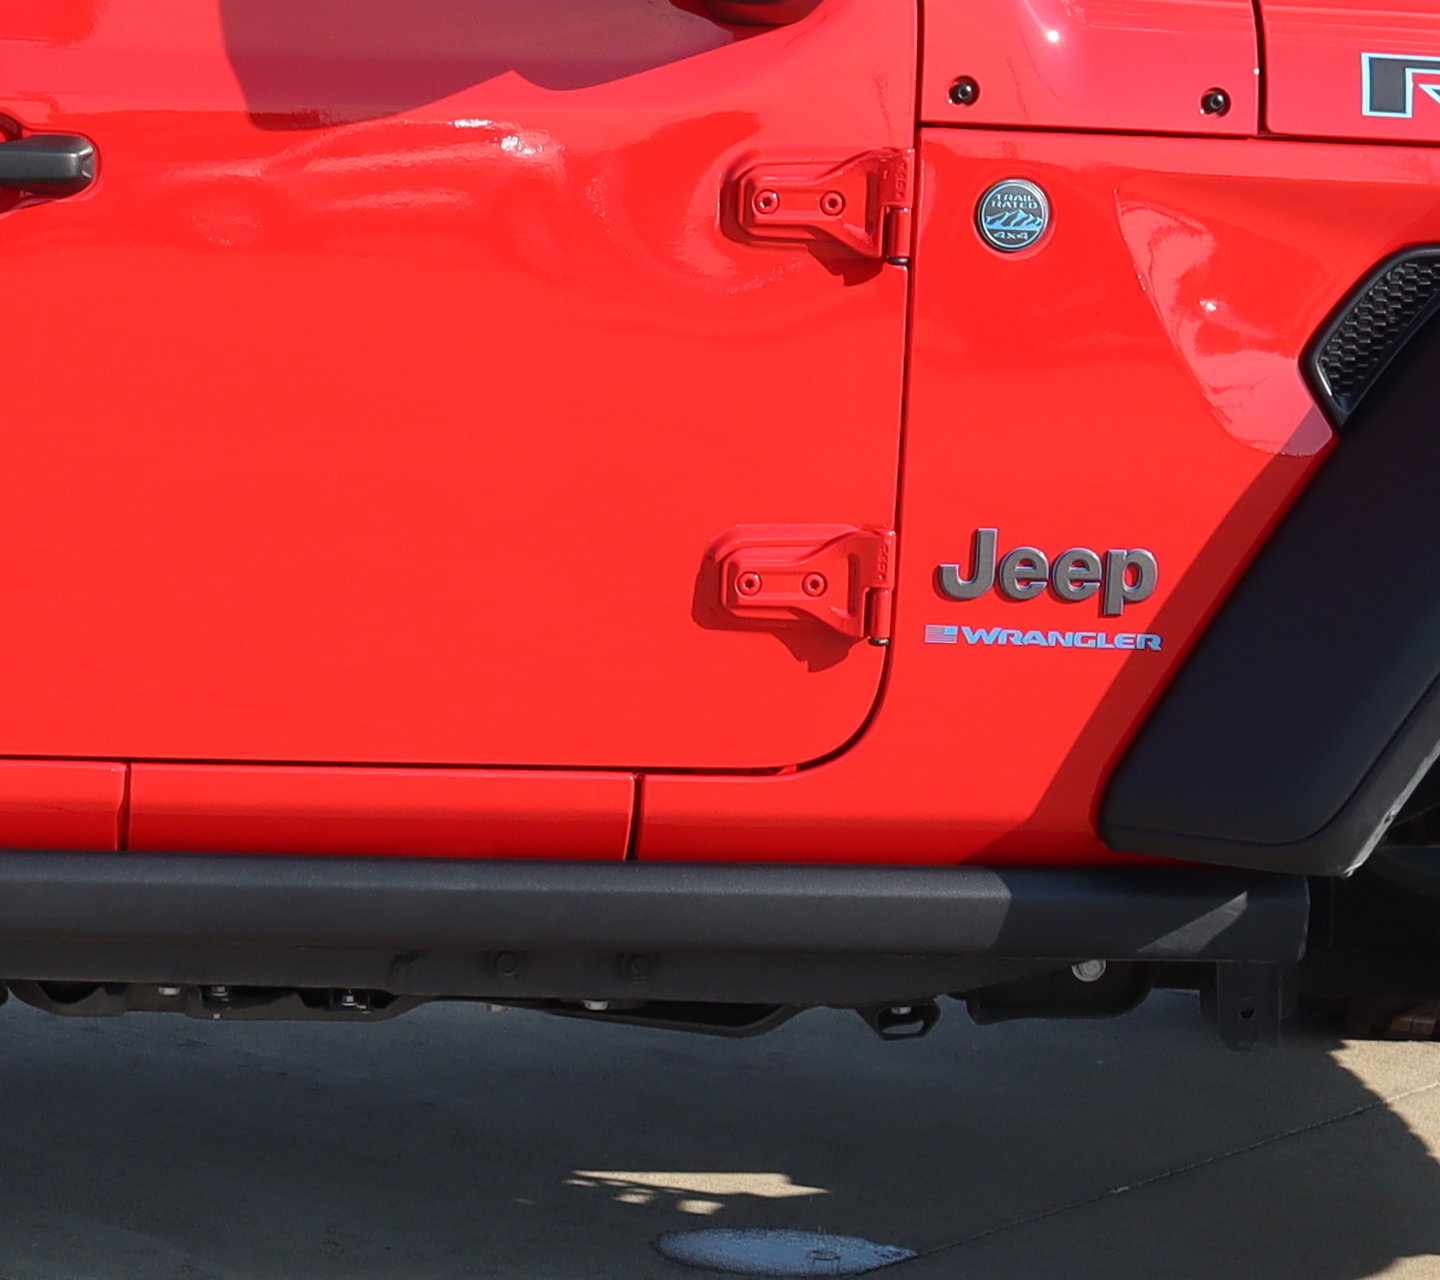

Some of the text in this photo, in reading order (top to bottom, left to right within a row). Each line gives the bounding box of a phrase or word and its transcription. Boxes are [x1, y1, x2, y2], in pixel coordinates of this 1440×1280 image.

[991, 201, 1038, 209] RATED
[994, 193, 1034, 203] TRAIL
[937, 527, 1159, 617] Jeep
[960, 625, 1162, 651] WRANGLER
